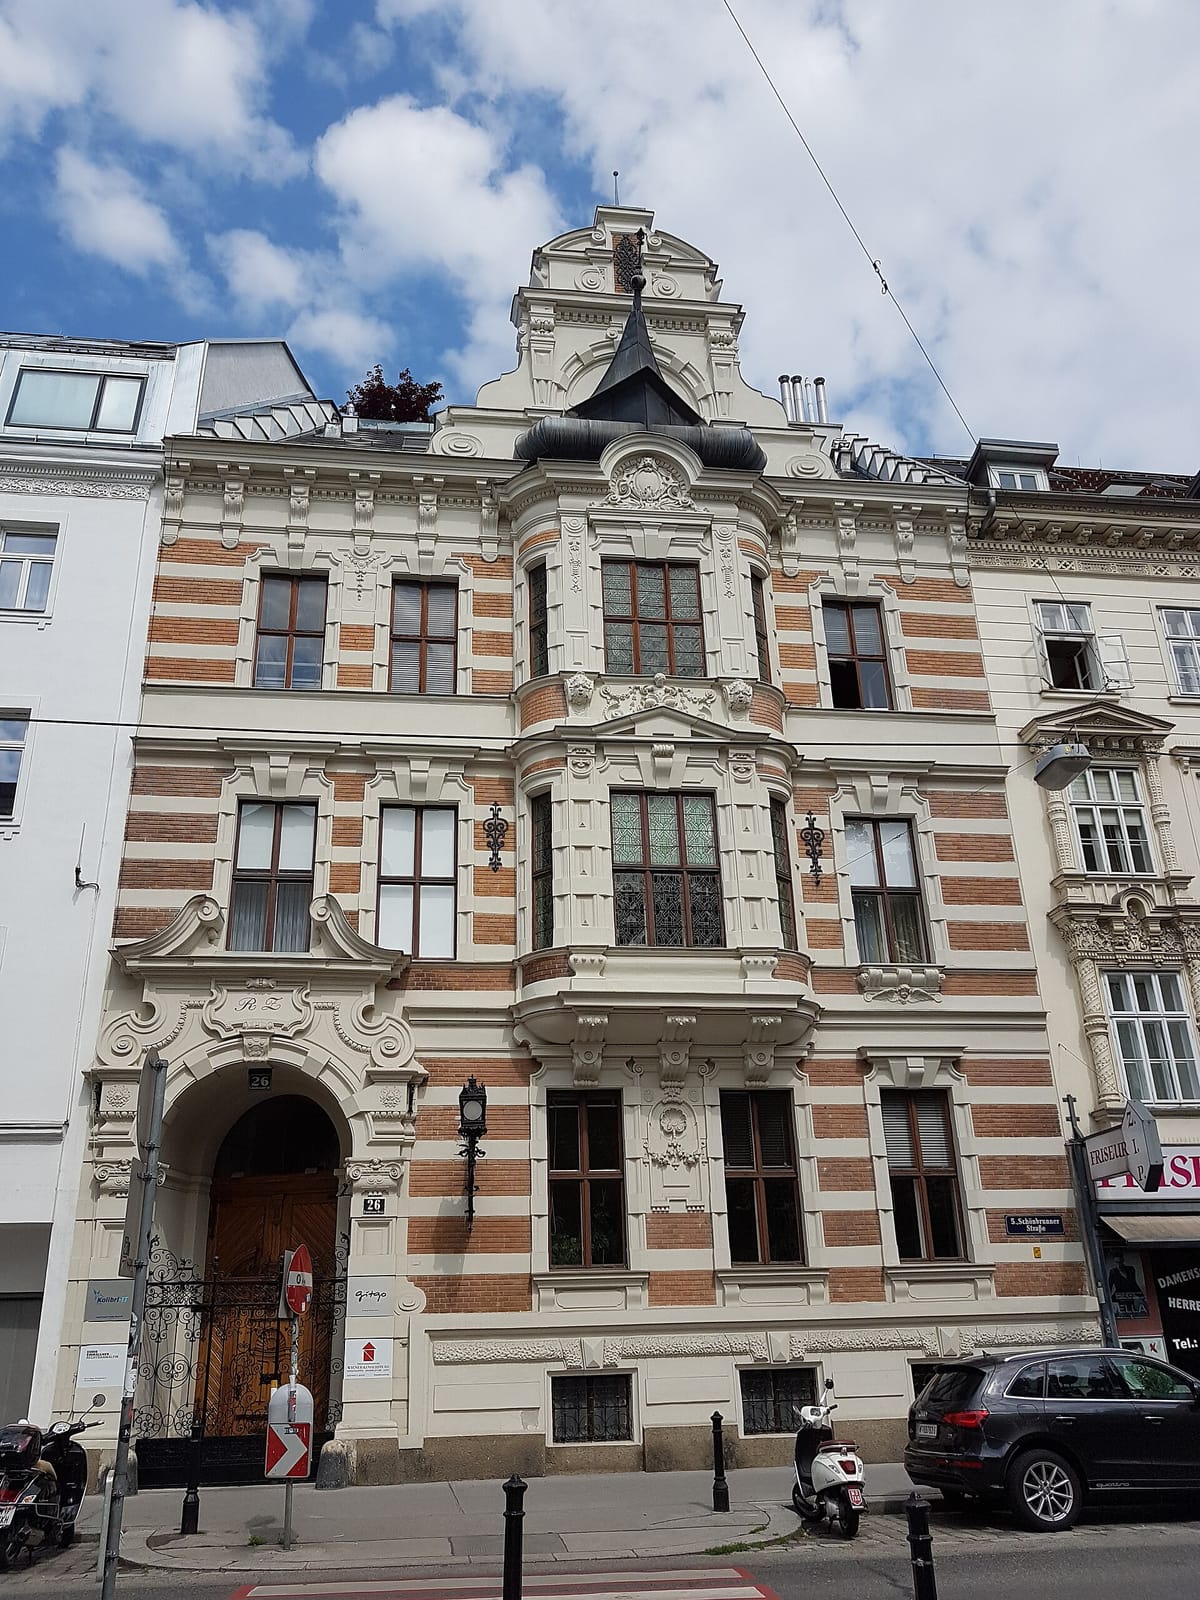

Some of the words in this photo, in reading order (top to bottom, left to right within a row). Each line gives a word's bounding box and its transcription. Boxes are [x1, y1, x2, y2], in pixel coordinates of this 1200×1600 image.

[251, 1077, 269, 1086] 26
[1090, 1141, 1129, 1166] FRISEUR
[367, 1199, 381, 1210] 26
[1158, 1267, 1200, 1288] DAMENS
[355, 1290, 387, 1302] gitgo
[1172, 1337, 1198, 1350] Tel.:
